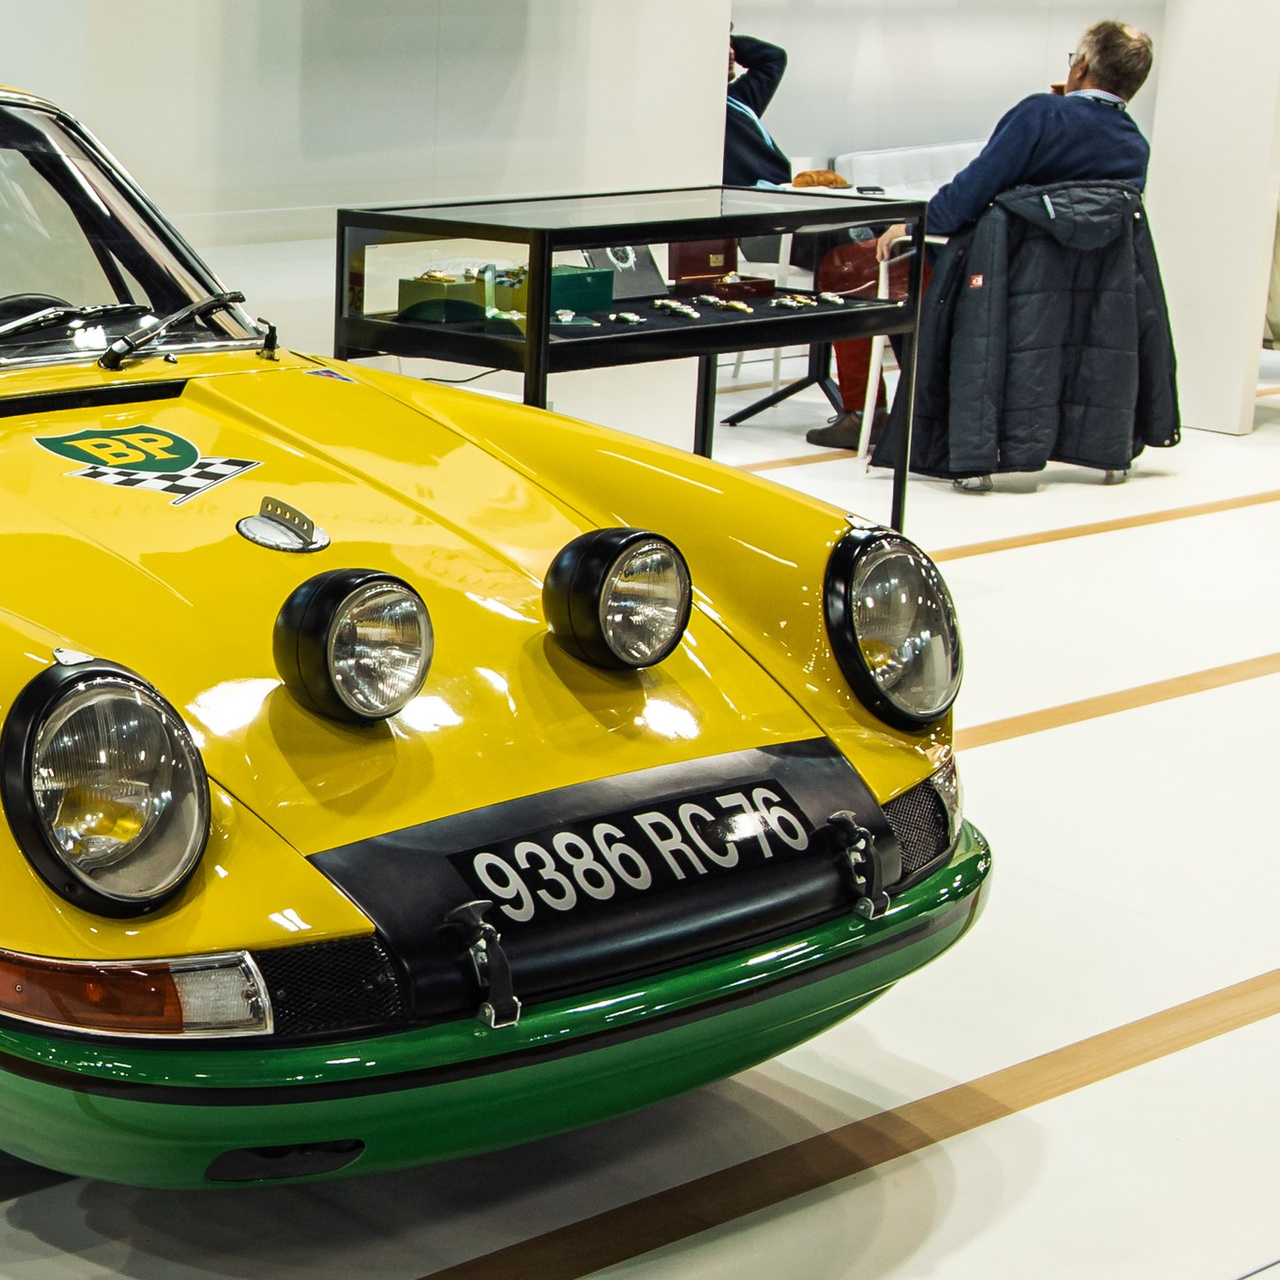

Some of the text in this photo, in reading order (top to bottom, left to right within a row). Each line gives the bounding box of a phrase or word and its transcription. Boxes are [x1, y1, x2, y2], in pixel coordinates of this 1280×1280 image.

[62, 432, 181, 467] BP
[472, 787, 810, 923] 9386 RC 76
